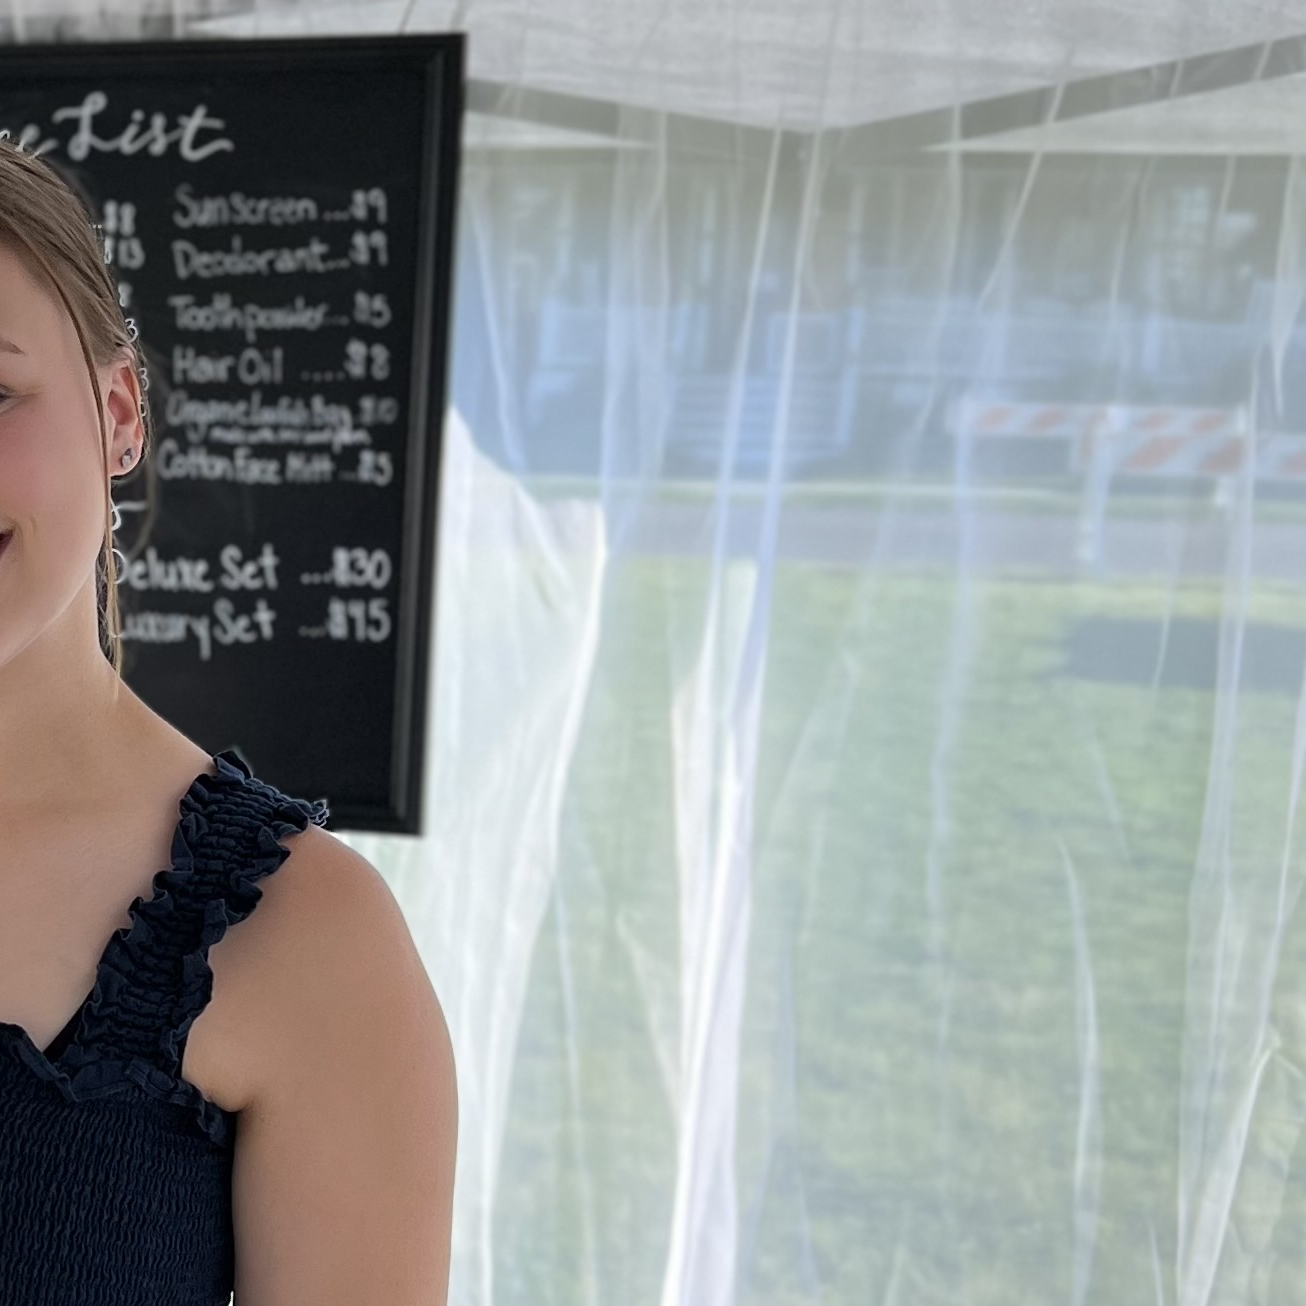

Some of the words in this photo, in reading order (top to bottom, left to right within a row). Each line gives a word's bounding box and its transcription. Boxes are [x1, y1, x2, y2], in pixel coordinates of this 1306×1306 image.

[51, 91, 235, 161] List
[171, 234, 330, 280] Deodorant
[237, 347, 284, 385] Oil
[220, 543, 280, 590] Set
[332, 546, 392, 590] $30
[213, 598, 277, 646] Set
